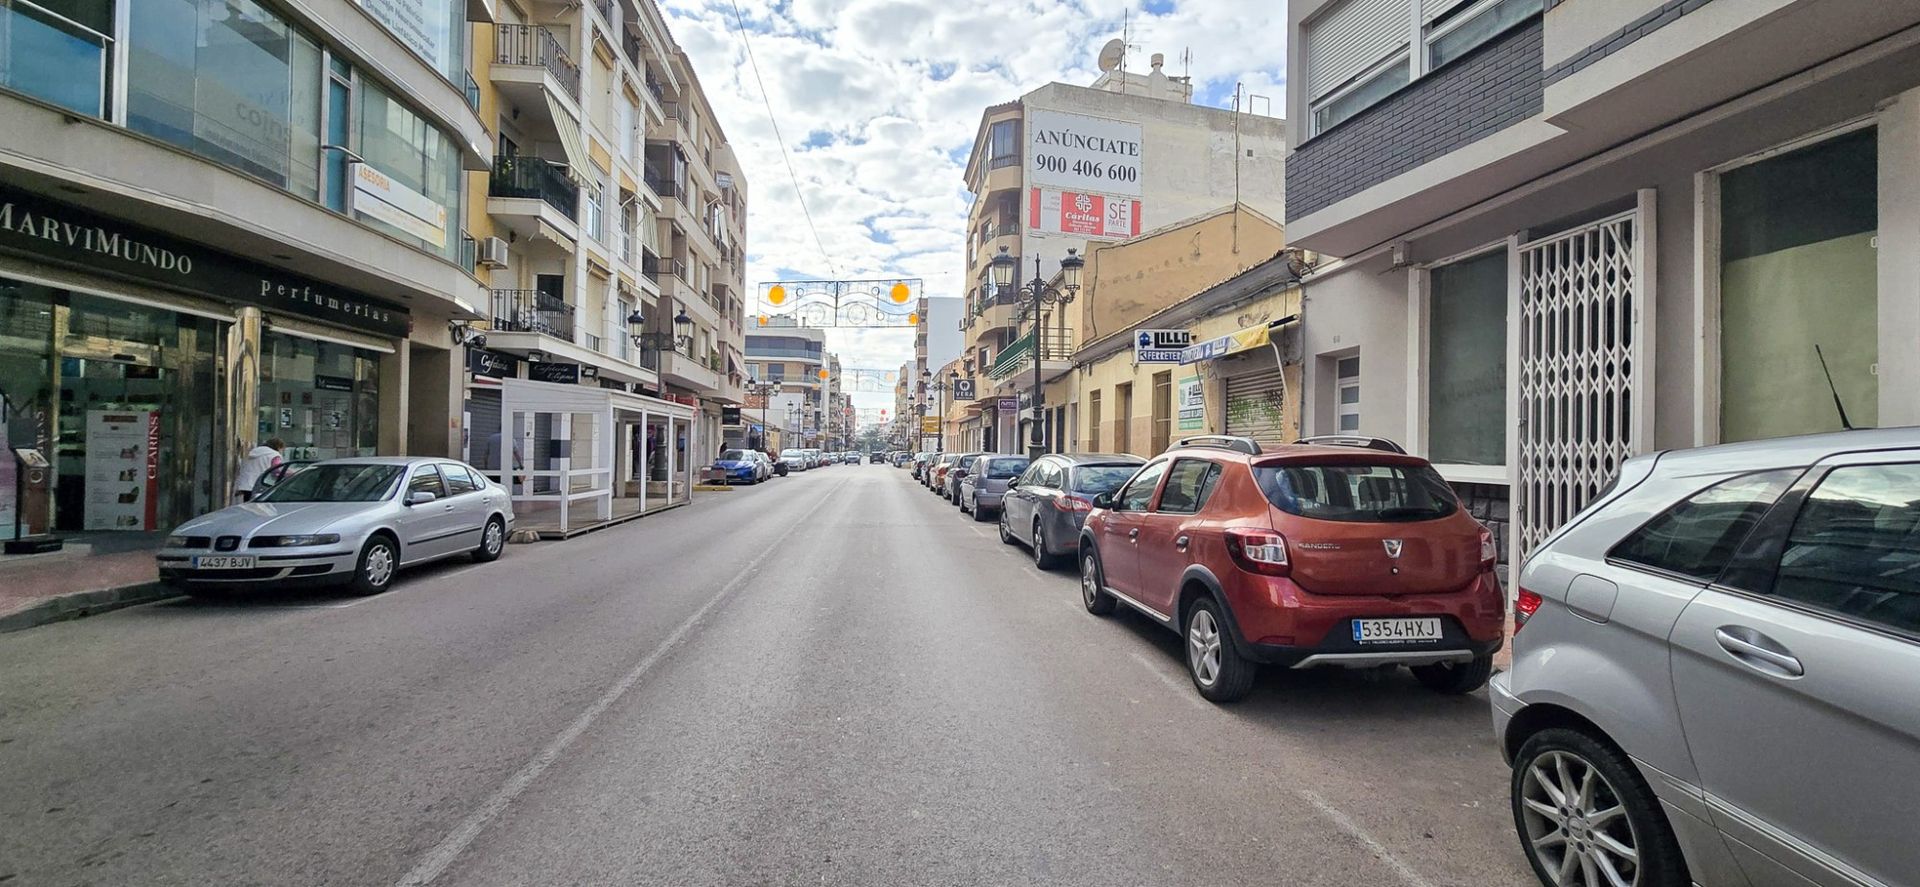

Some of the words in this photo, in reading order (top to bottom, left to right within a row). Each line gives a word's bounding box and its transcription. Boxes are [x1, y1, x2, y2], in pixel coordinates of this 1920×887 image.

[1035, 129, 1139, 156] ANÚNCIATE
[1036, 153, 1067, 174] 900
[1072, 159, 1102, 178] 406
[1108, 164, 1136, 183] 600
[1065, 212, 1100, 223] Cáritas
[1109, 199, 1127, 220] SÉ
[1108, 219, 1127, 228] PARTE
[261, 280, 389, 322] perfumerías
[1154, 332, 1190, 349] LILLO
[148, 416, 159, 480] CLARINS
[200, 557, 227, 568] 4437
[231, 557, 251, 568] BJV
[1362, 621, 1435, 637] 5354HXJ
